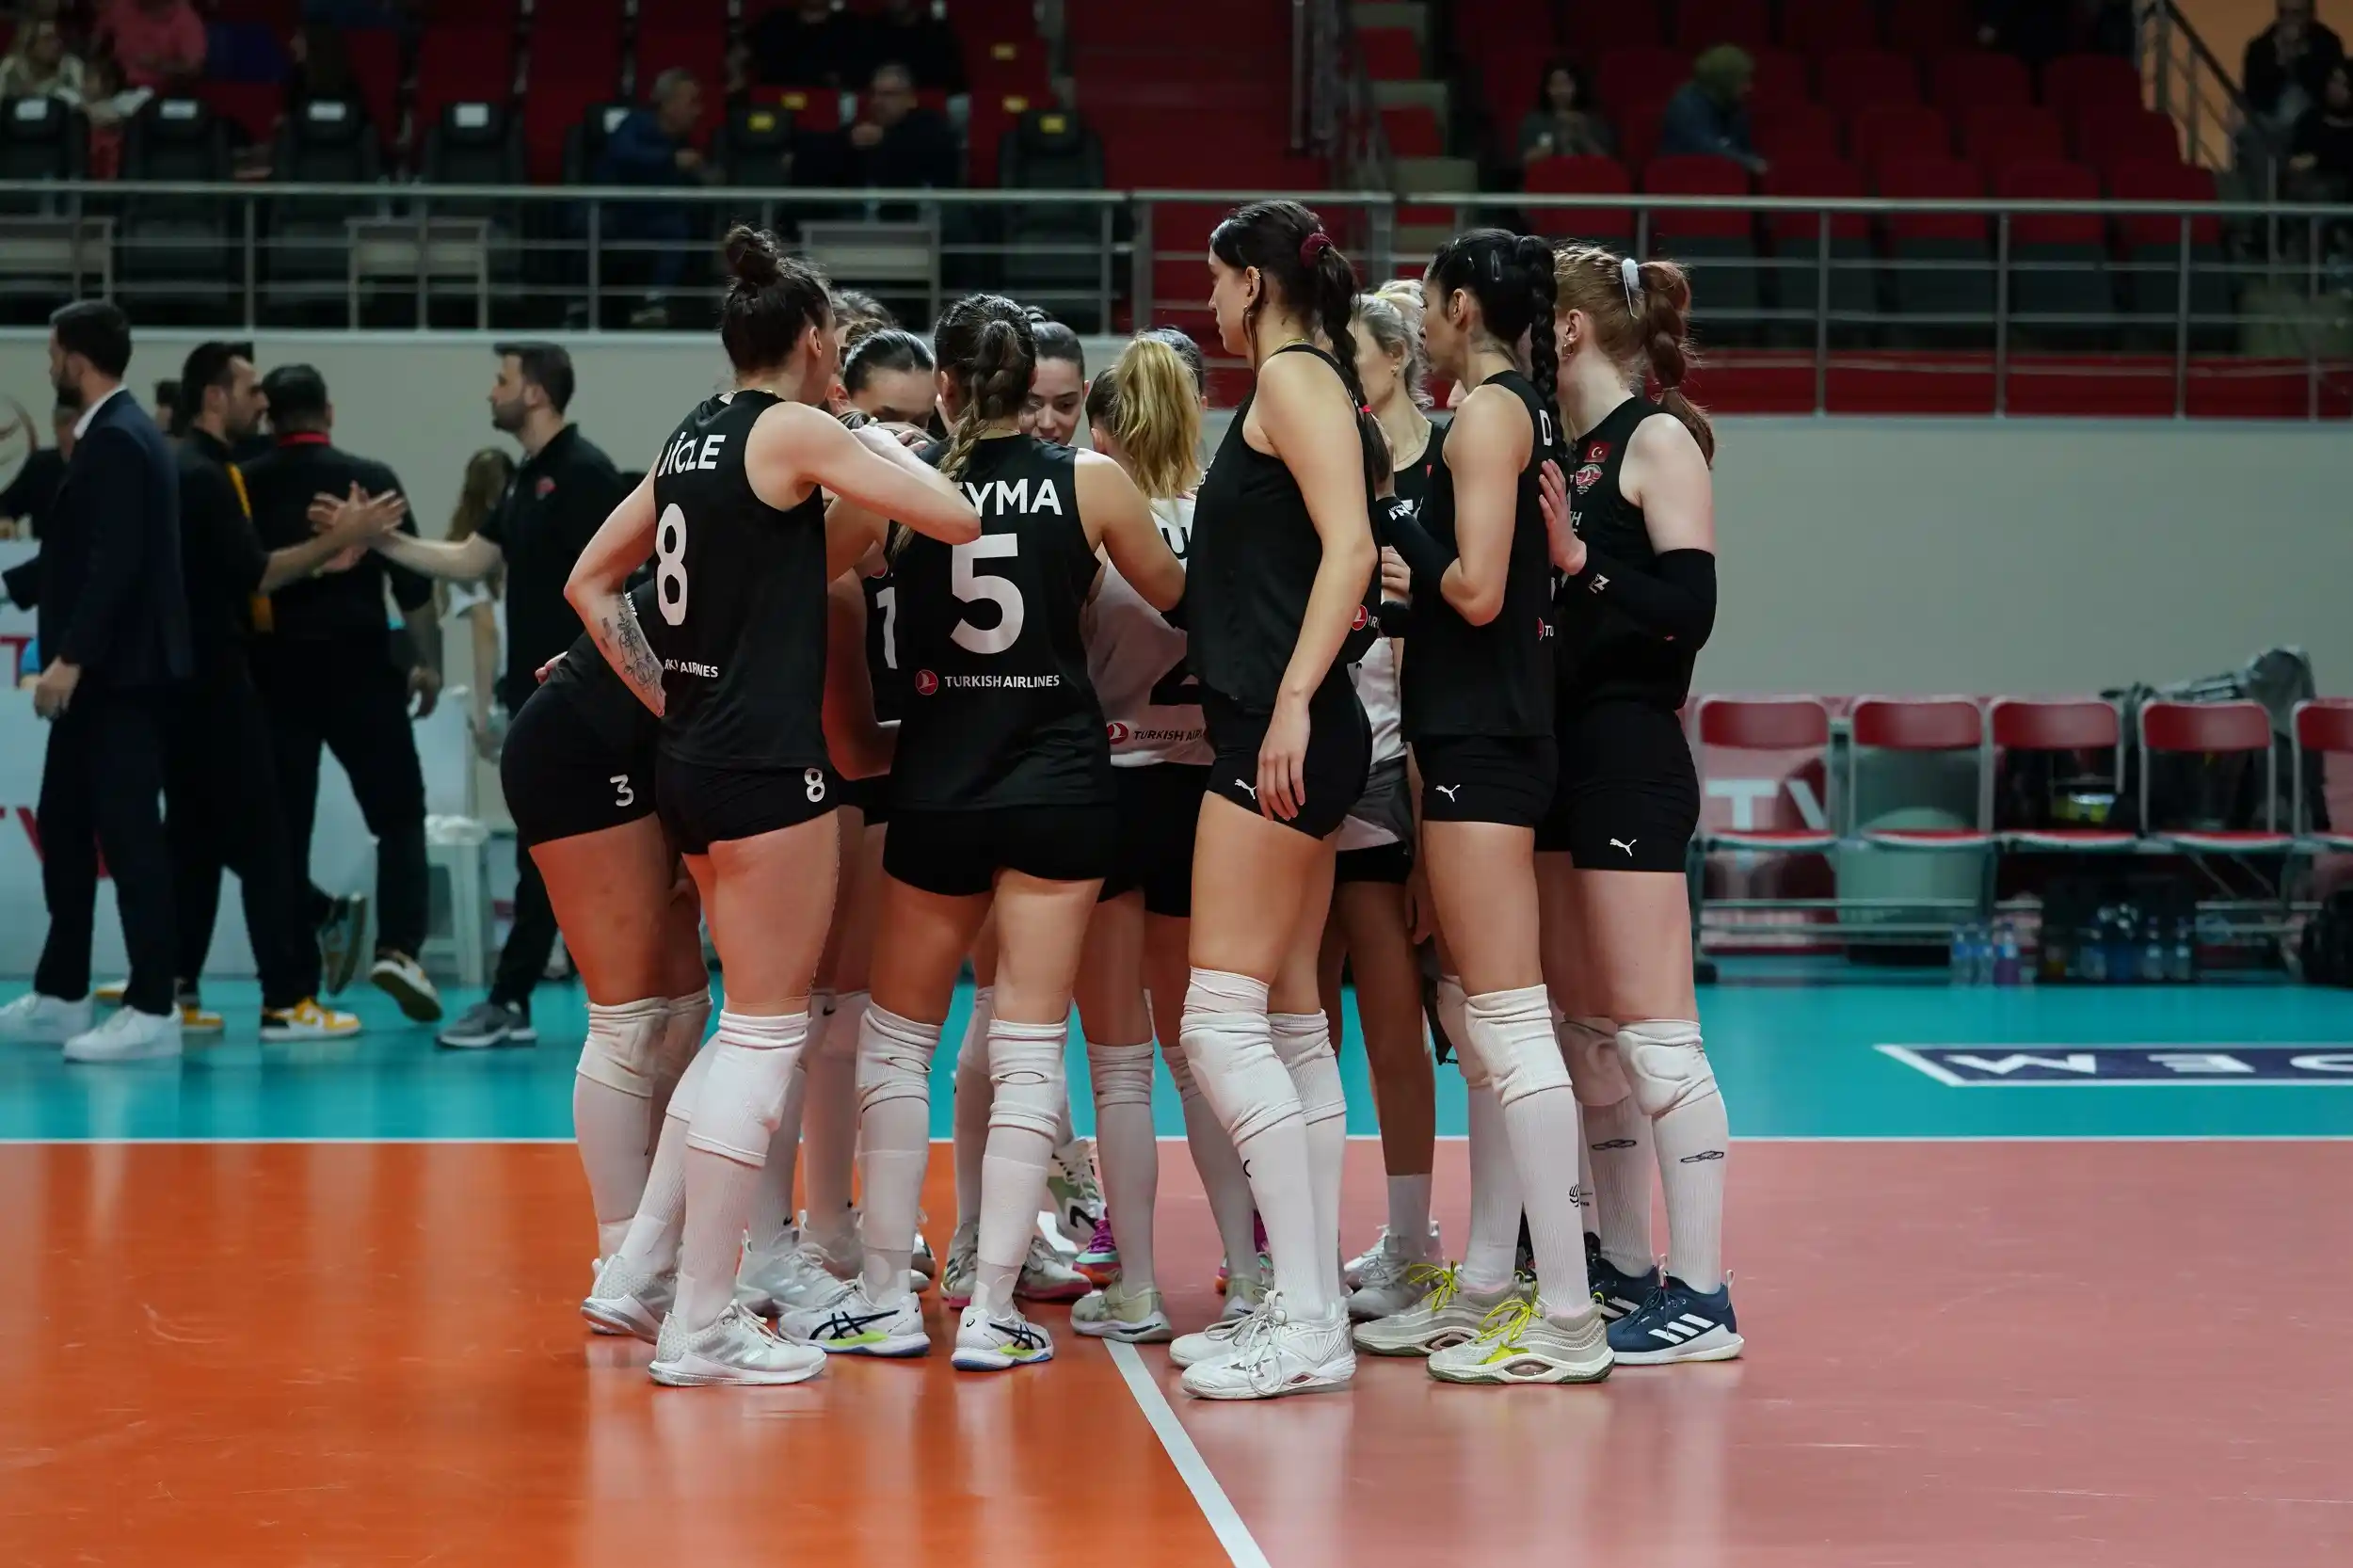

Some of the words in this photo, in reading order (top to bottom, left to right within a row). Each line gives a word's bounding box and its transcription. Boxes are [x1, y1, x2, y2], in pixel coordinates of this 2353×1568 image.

[953, 478, 1063, 518] YMA
[655, 503, 688, 626] 8
[950, 533, 1025, 654] 5
[944, 675, 1002, 688] TURKISH
[1002, 674, 1060, 688] AIRLINES
[1133, 729, 1184, 742] TURKISH
[609, 774, 634, 808] 3
[804, 767, 825, 803] 8
